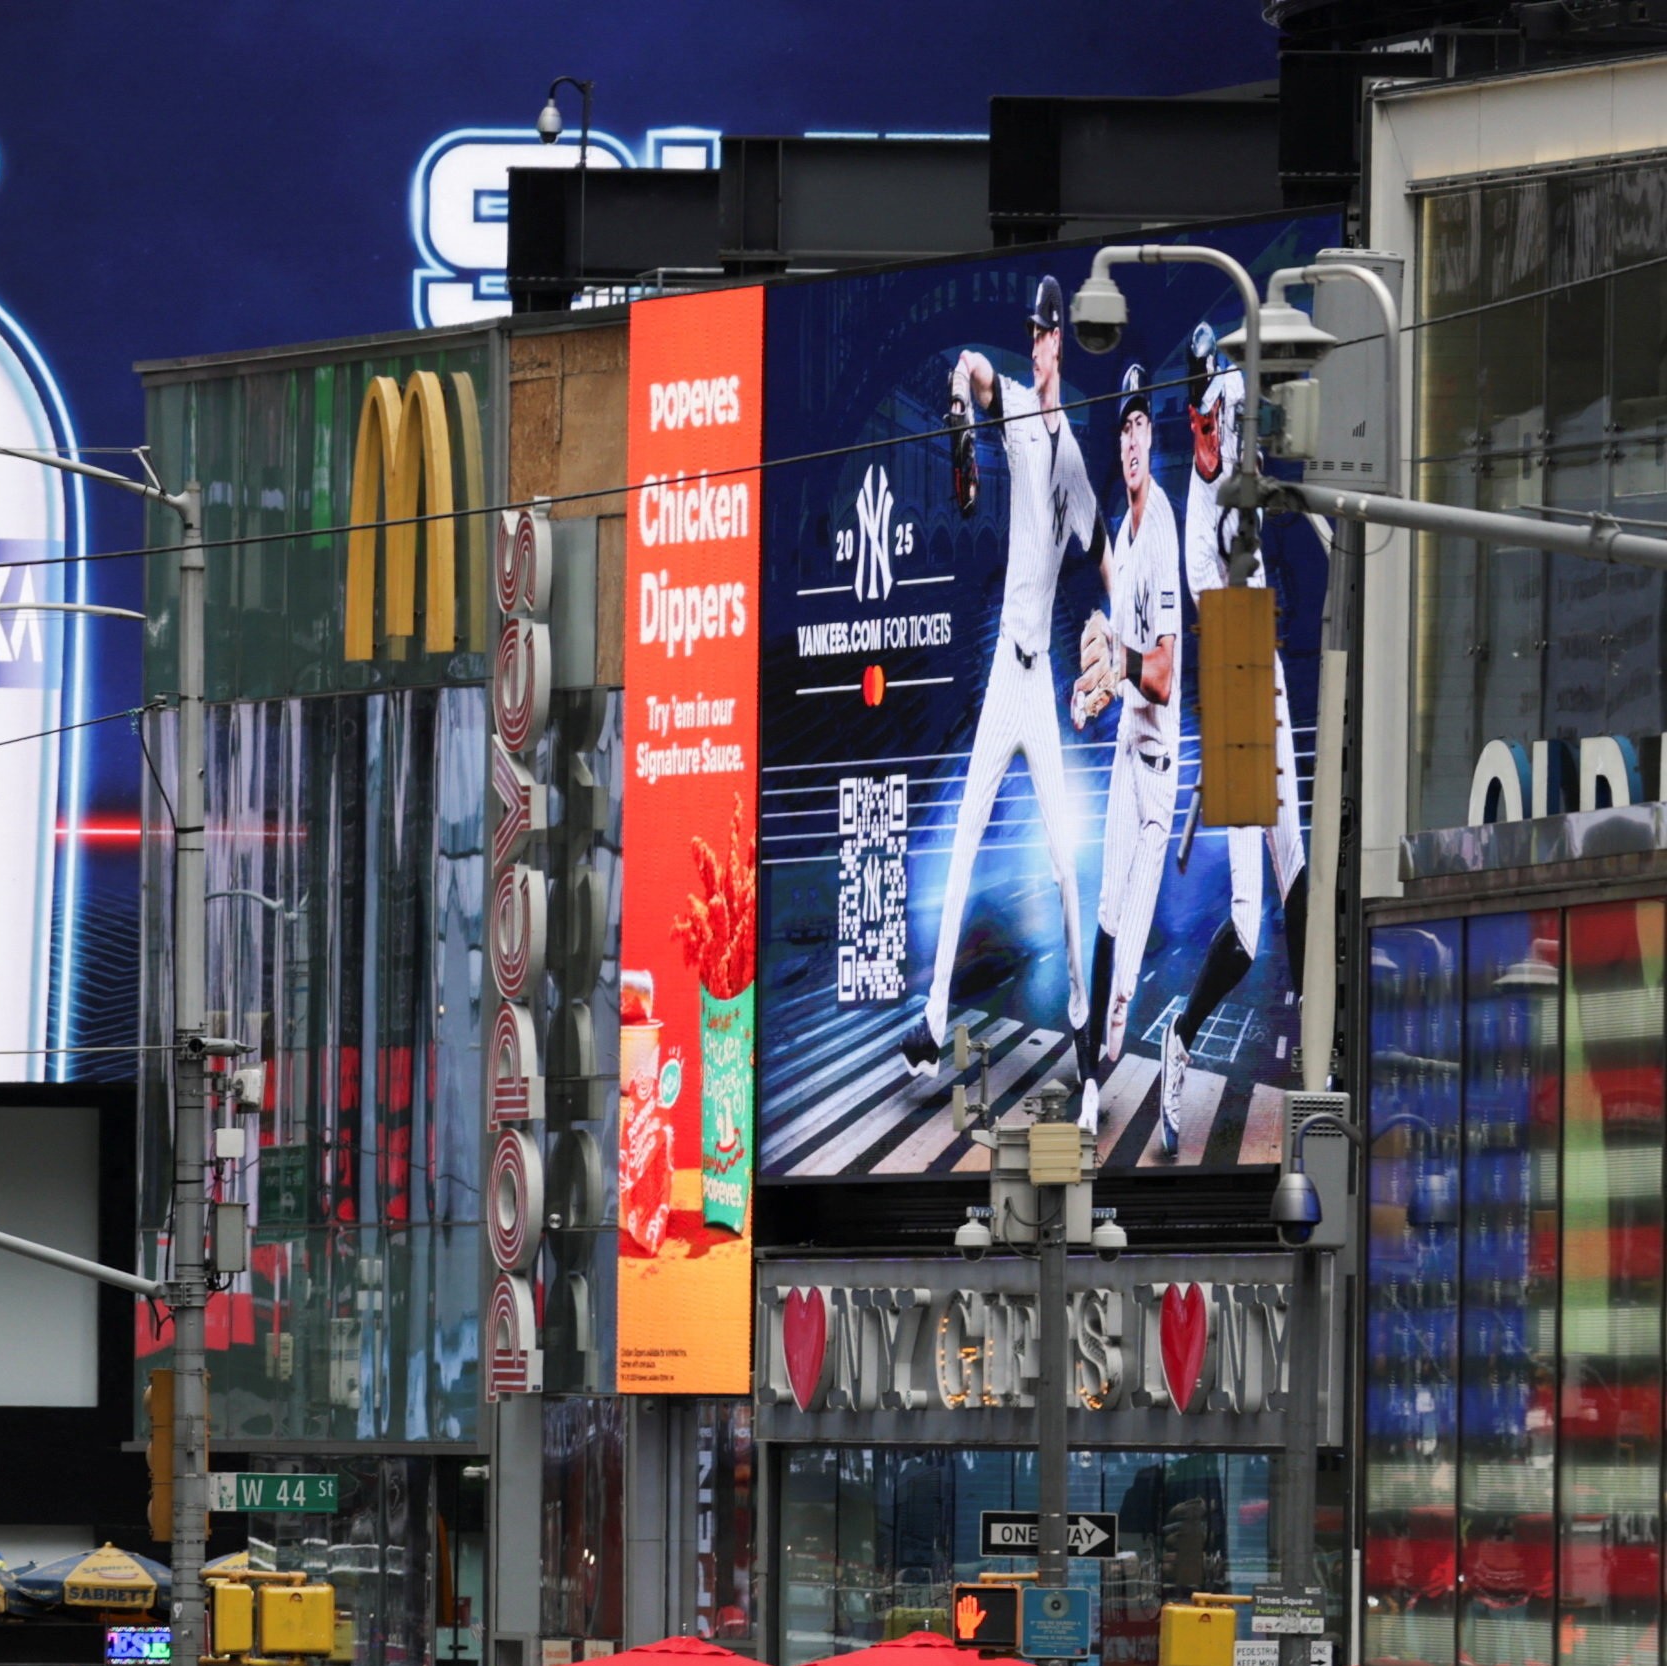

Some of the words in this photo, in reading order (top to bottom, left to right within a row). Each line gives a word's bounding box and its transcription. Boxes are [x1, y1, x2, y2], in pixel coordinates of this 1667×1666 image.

[639, 470, 748, 546] Chicken
[835, 529, 854, 561] 20
[895, 523, 913, 556] 25
[639, 570, 746, 657] Dippers
[797, 619, 881, 657] YANKEES.COM
[884, 616, 907, 649] FOR
[909, 612, 951, 645] TICKETS
[646, 695, 669, 737] Try
[672, 694, 696, 729] 'em
[698, 691, 710, 727] in
[712, 698, 735, 726] our
[636, 742, 700, 784] Signature
[702, 738, 744, 773] Sauce.
[241, 1477, 264, 1506] W
[275, 1477, 307, 1508] 44
[318, 1477, 335, 1499] St
[1000, 1525, 1039, 1543] ONE
[69, 1586, 151, 1602] SABRETT
[1237, 1647, 1277, 1656] PEDESTRIA
